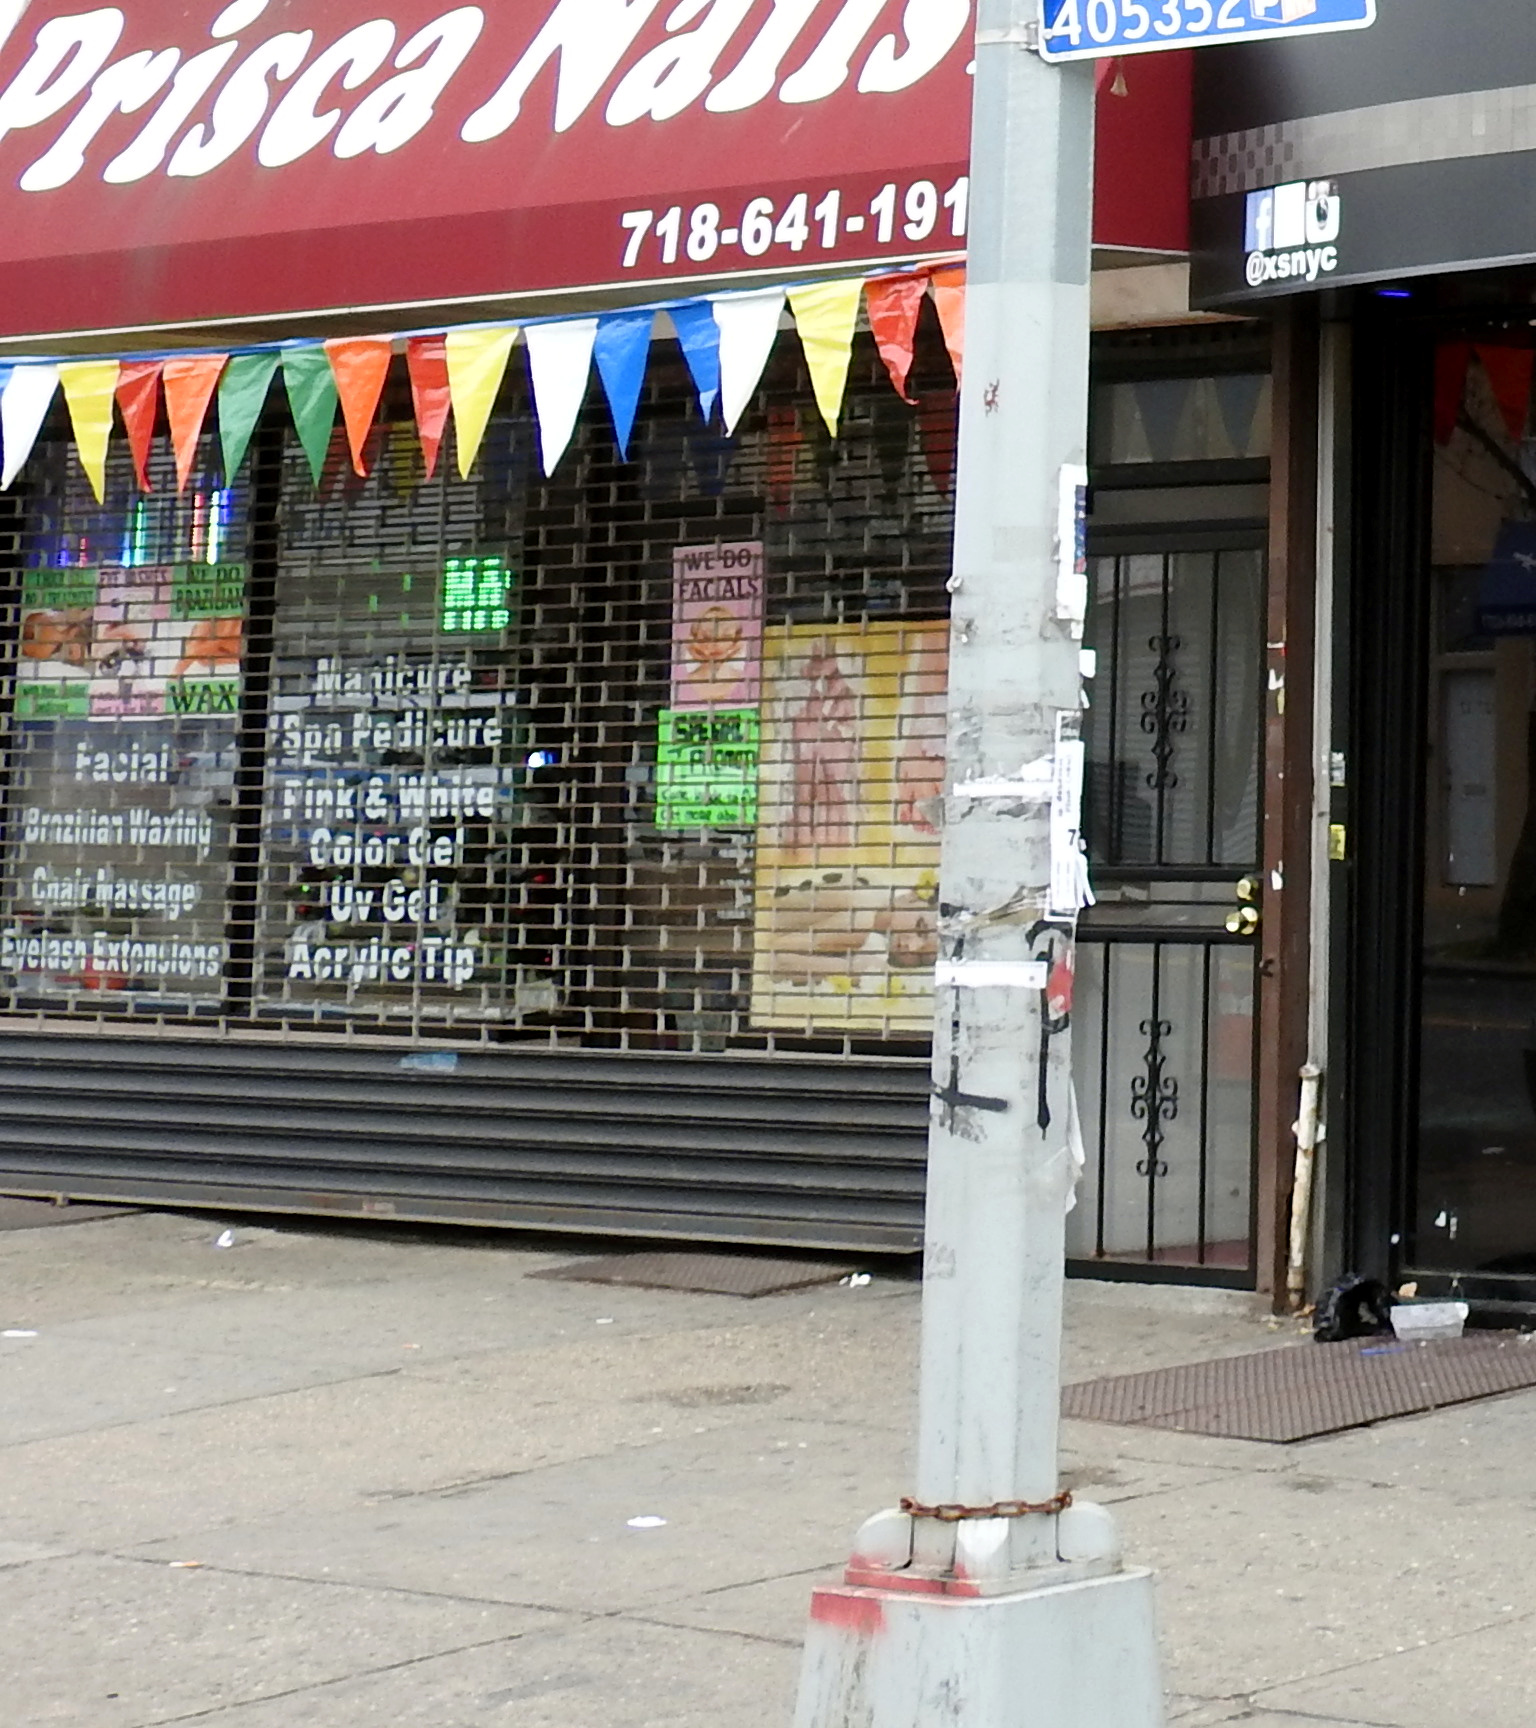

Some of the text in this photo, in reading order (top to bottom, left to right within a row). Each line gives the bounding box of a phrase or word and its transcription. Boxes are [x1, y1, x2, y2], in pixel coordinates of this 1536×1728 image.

[1246, 245, 1337, 286] @xsnyc
[679, 548, 751, 571] WE DO
[171, 683, 236, 711] WAX
[310, 827, 400, 868] Color
